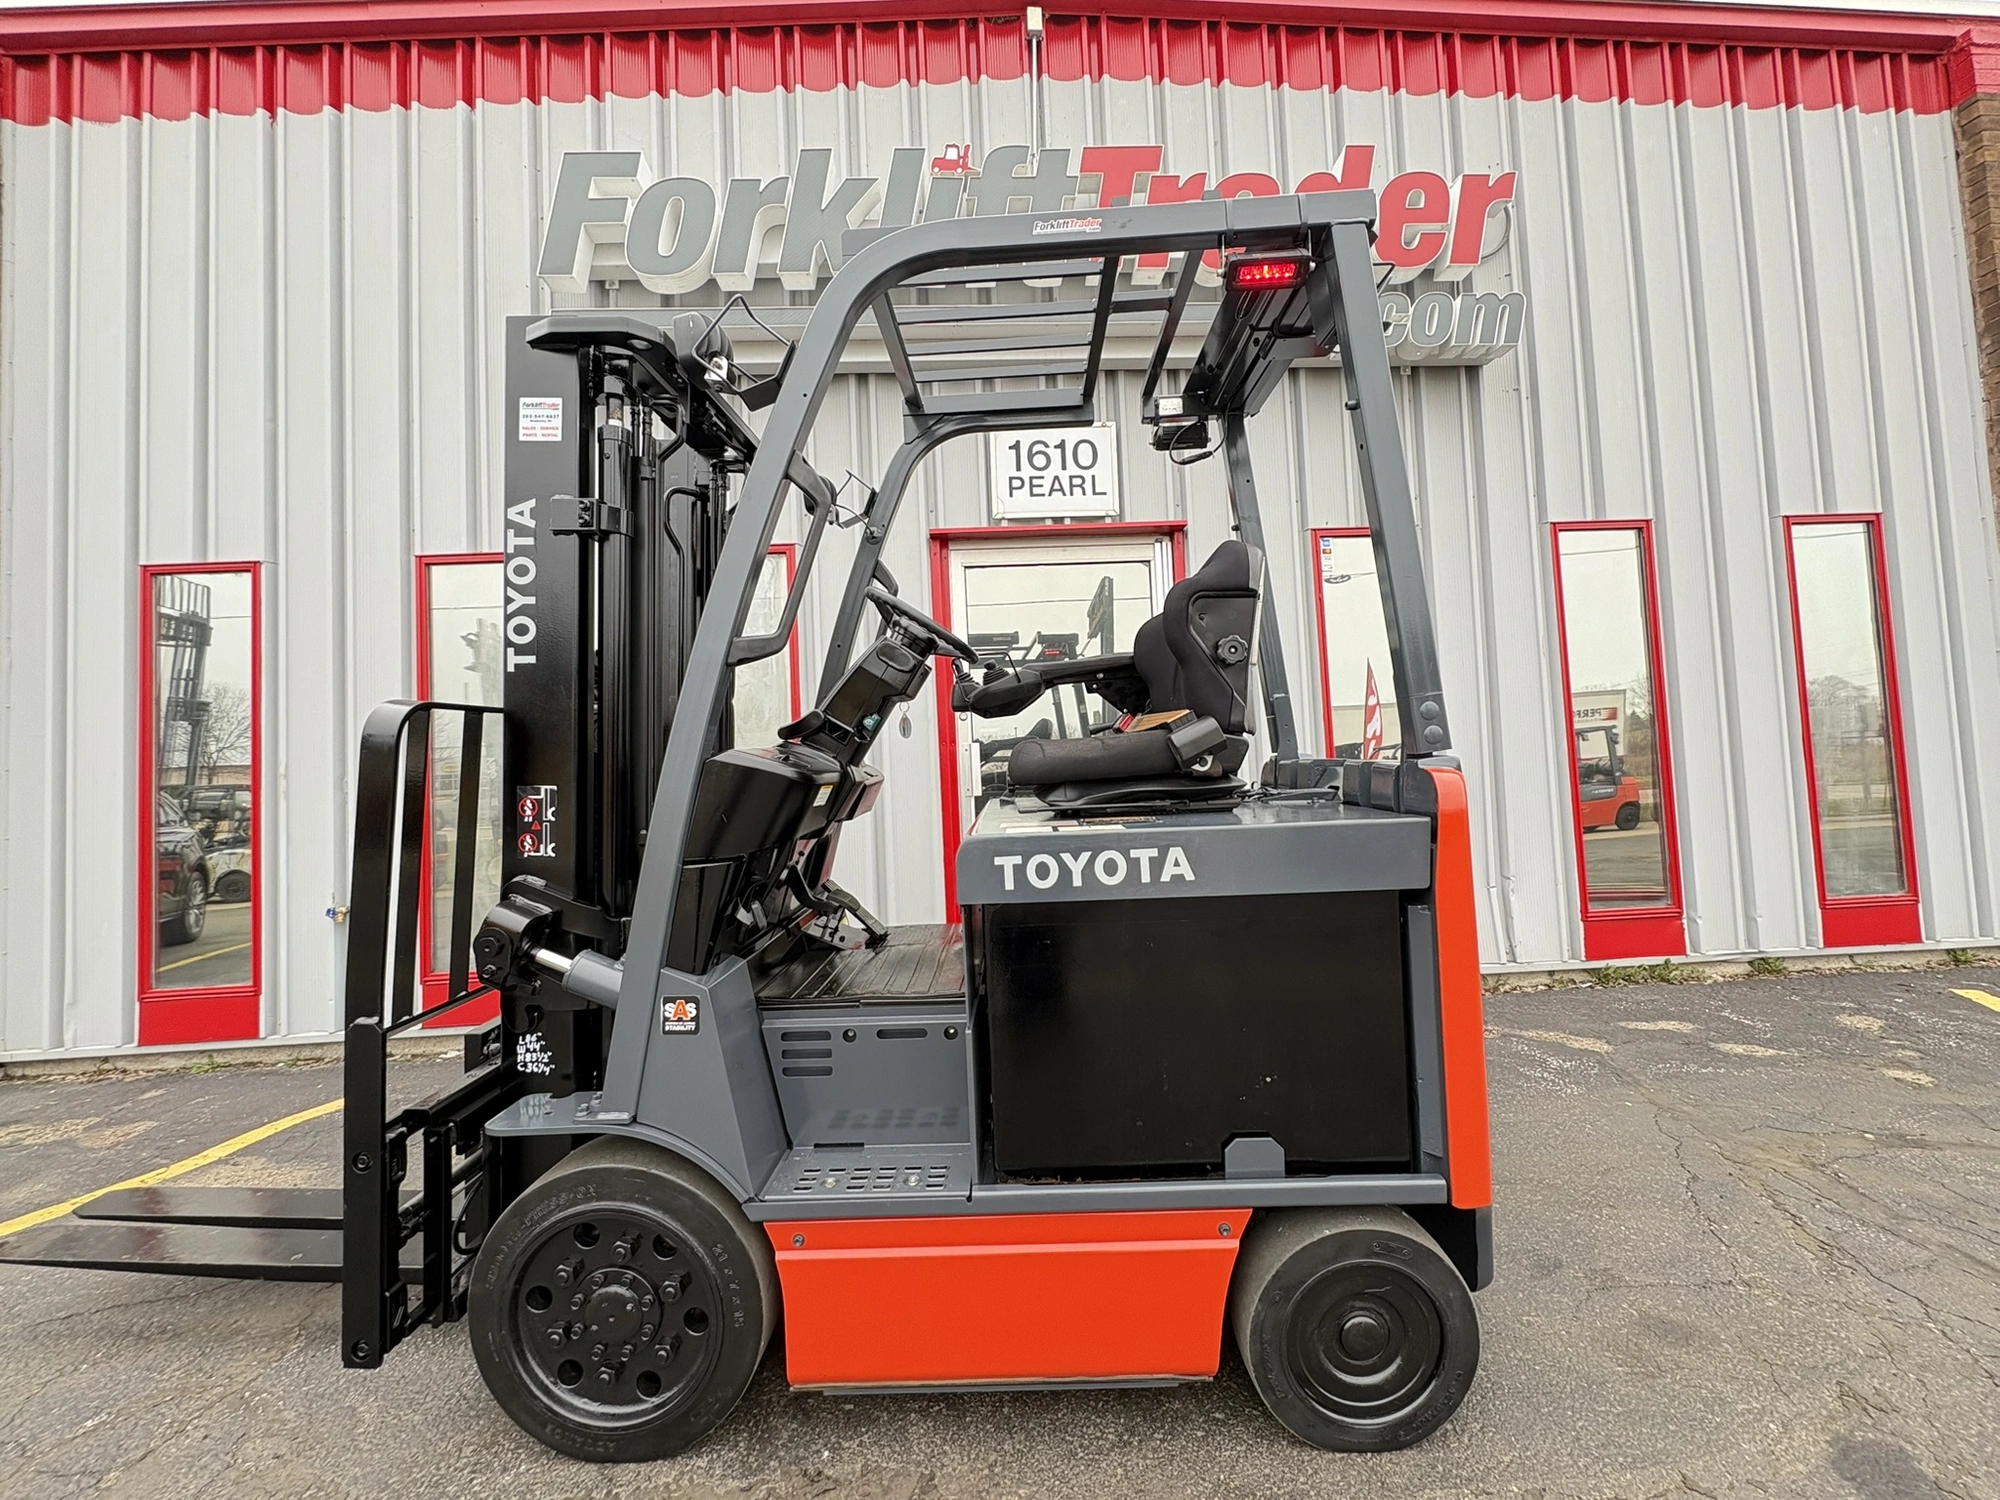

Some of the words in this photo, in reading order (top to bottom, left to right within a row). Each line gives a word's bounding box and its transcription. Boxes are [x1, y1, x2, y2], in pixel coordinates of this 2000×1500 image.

[1034, 217, 1102, 231] ForkliftTrader
[1008, 439, 1098, 472] 1610
[1008, 474, 1107, 498] PEARL
[506, 498, 537, 672] TOYOTA
[994, 847, 1196, 890] TOYOTA
[664, 999, 697, 1020] SAS
